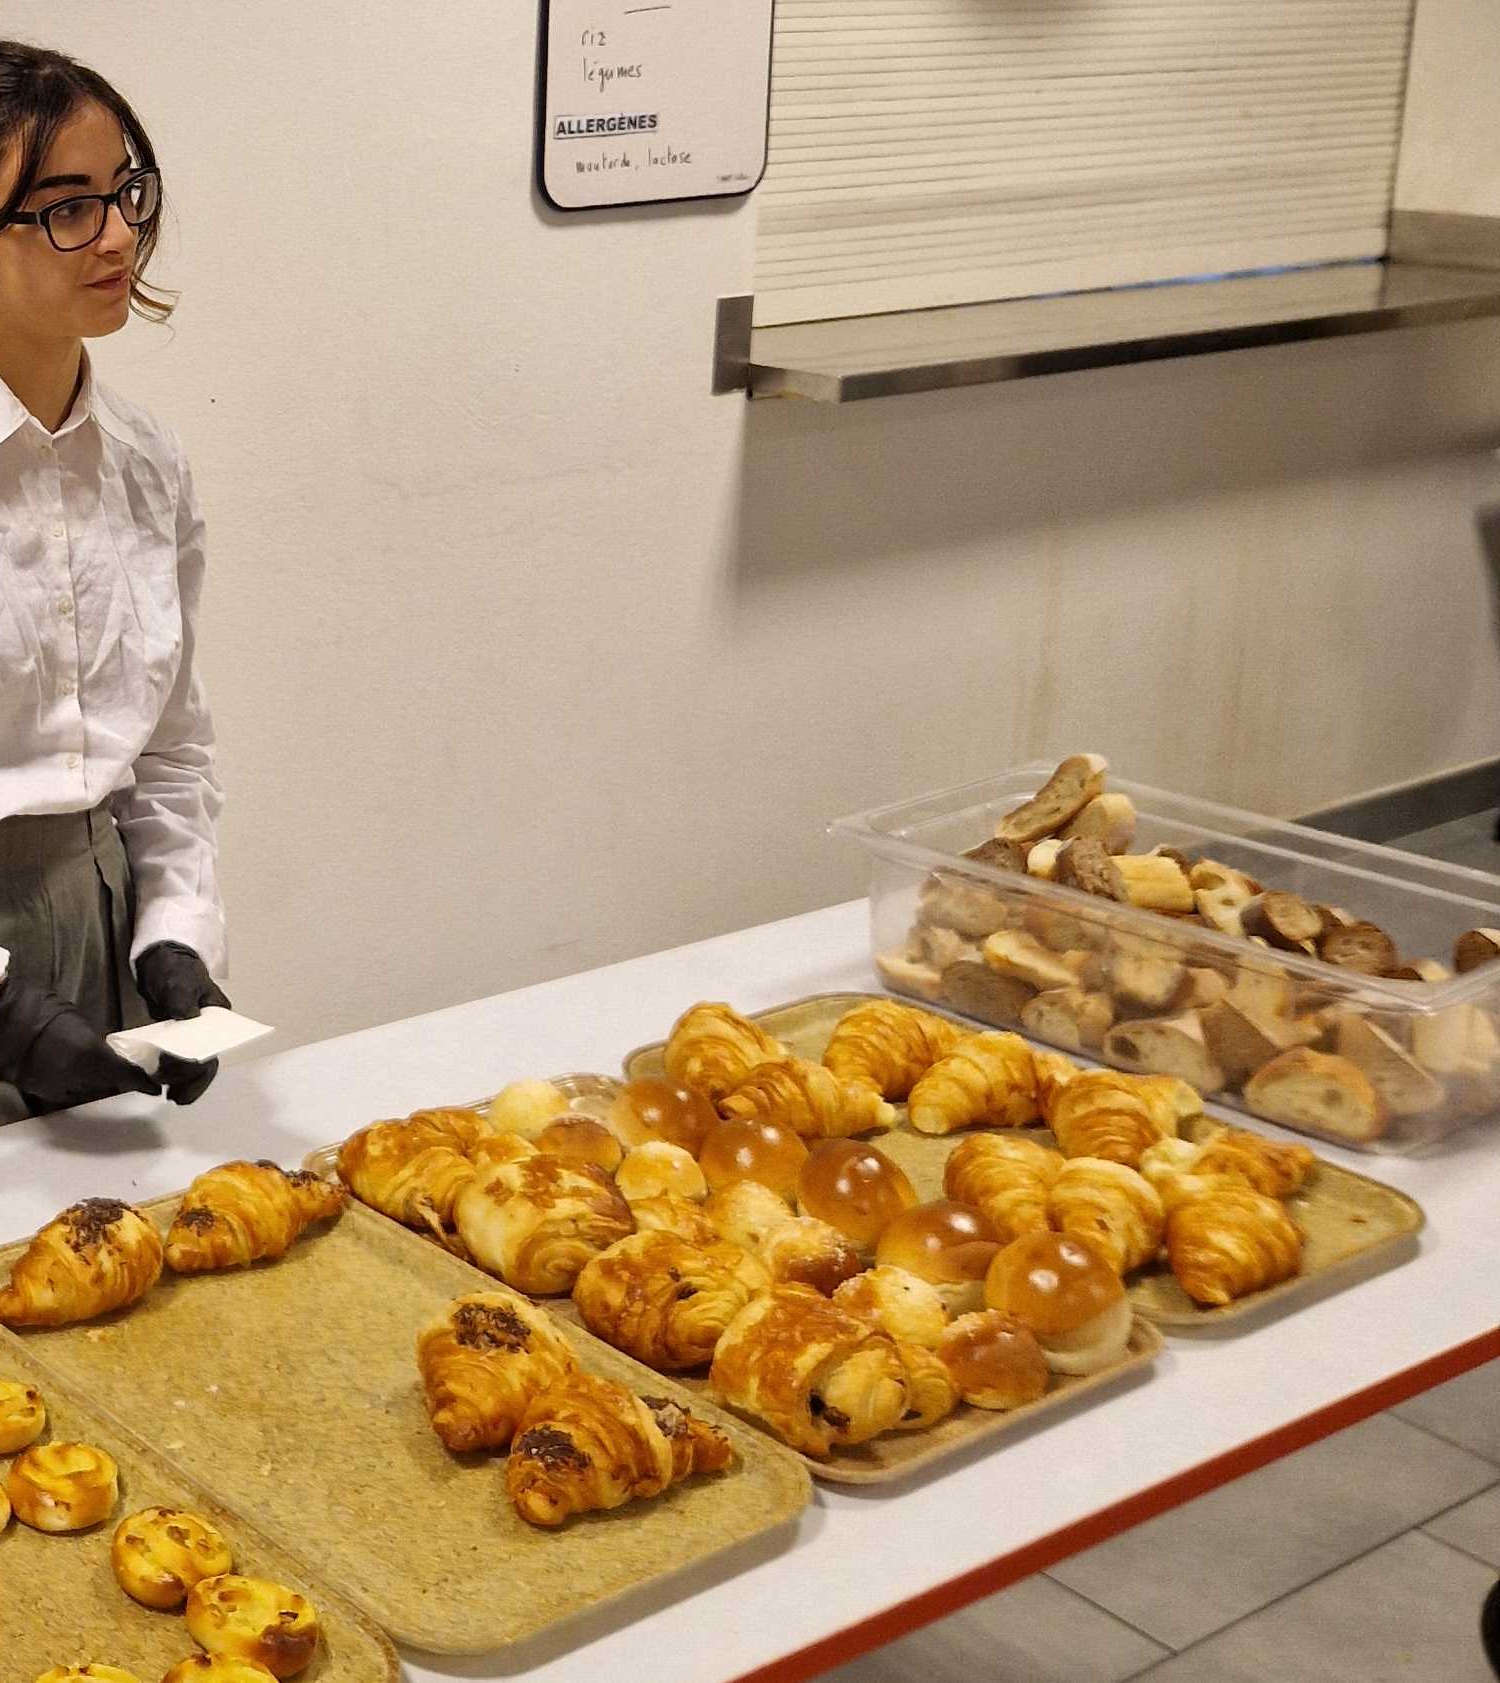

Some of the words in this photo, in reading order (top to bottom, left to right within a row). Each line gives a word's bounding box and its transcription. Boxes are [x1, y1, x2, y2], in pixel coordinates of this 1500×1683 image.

[583, 57, 643, 92] légumes
[556, 114, 658, 135] ALLERGÈNES
[647, 147, 693, 167] lactose
